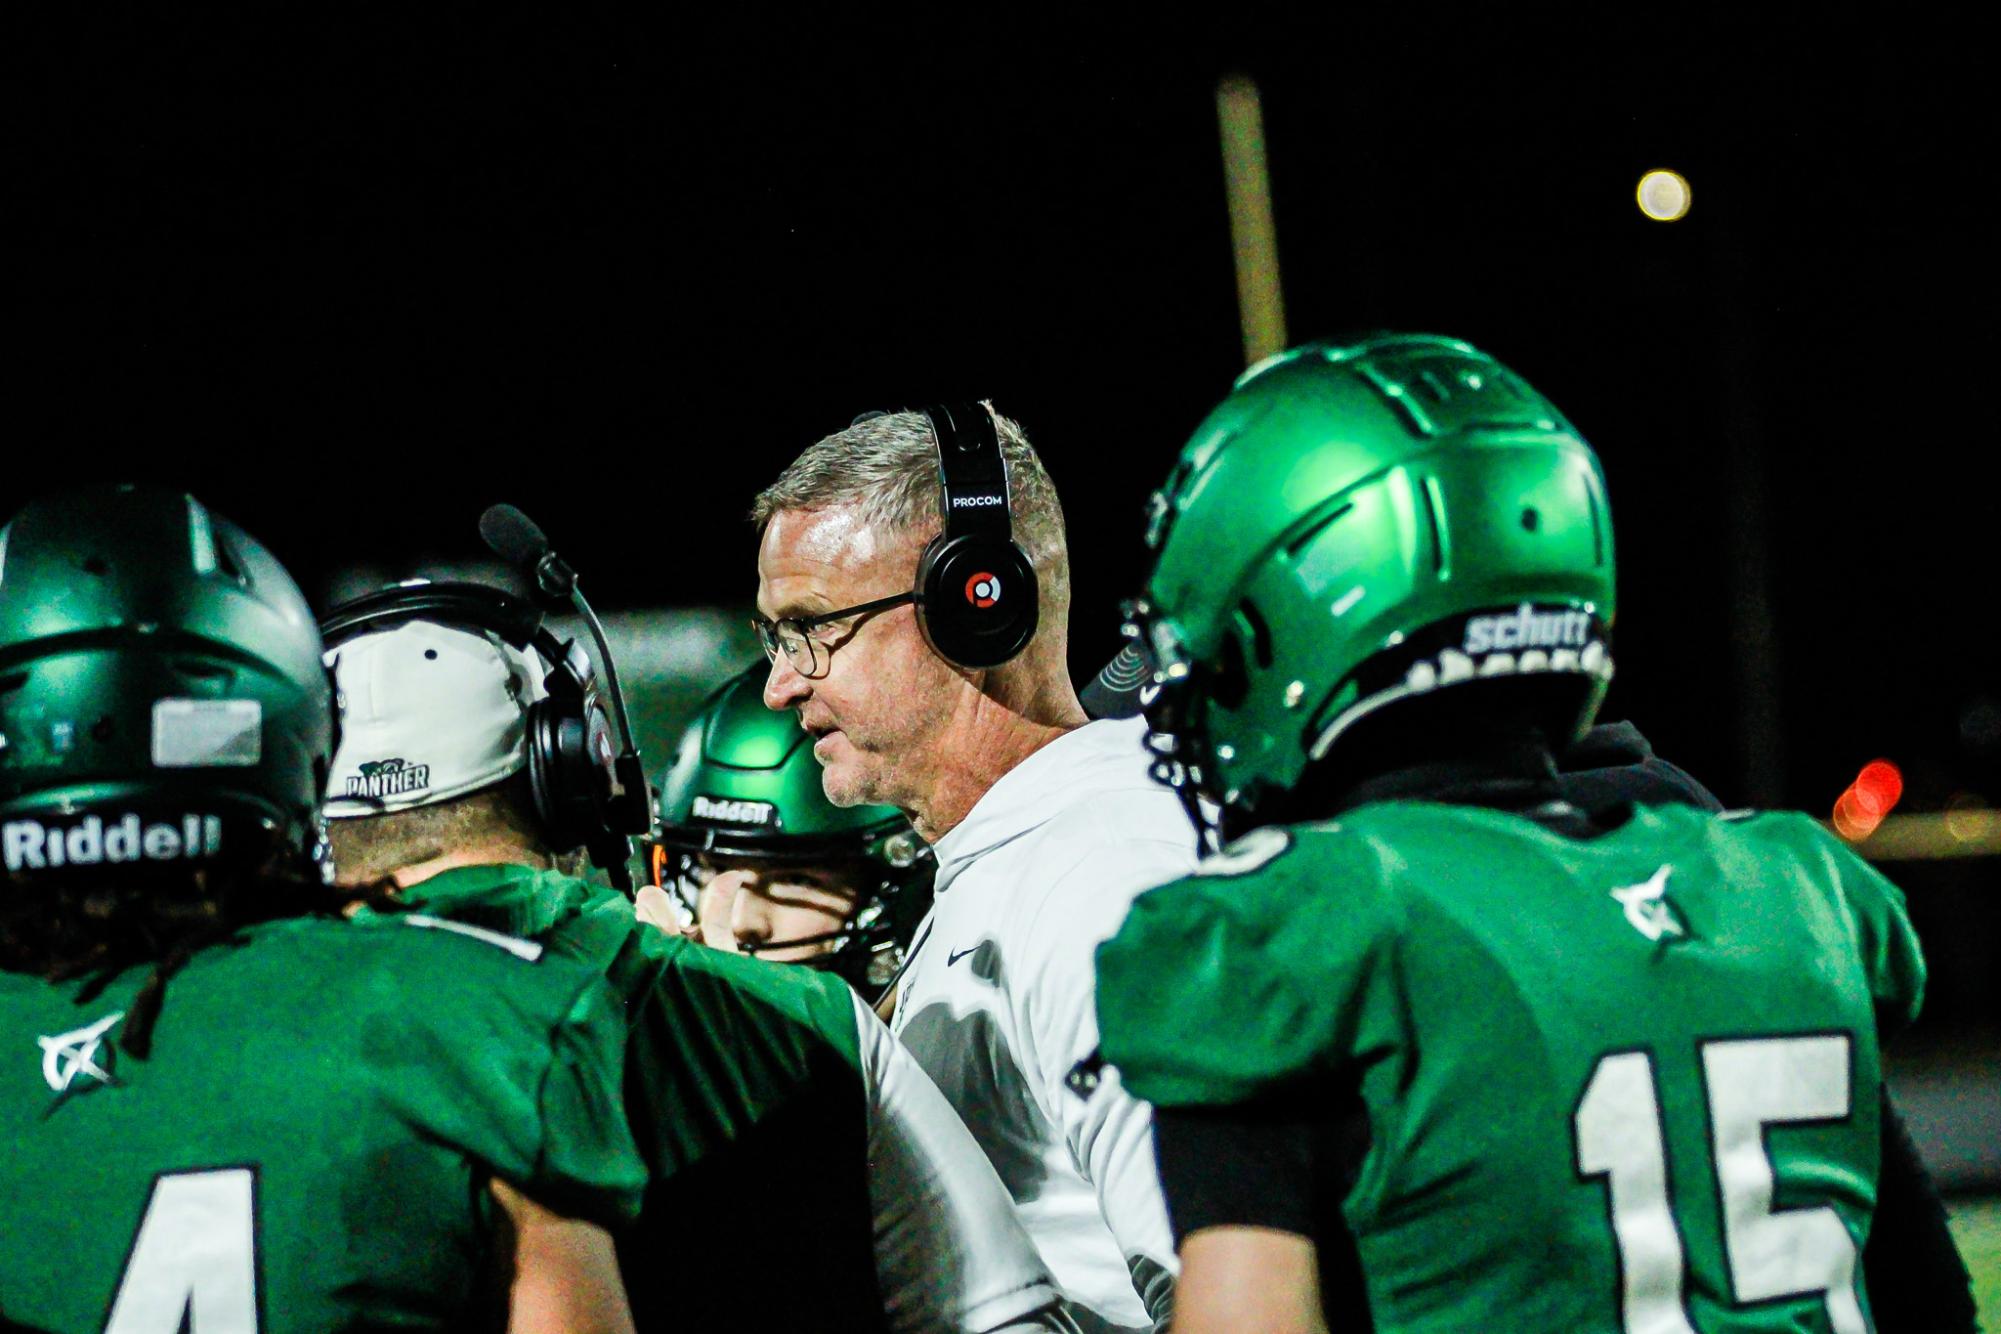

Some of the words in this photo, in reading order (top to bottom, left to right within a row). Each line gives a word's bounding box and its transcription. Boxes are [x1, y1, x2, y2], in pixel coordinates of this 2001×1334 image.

[953, 496, 1002, 508] PROCOM
[346, 764, 430, 798] PANTHER
[2, 813, 222, 872] Riddell
[1570, 1029, 1866, 1334] 15
